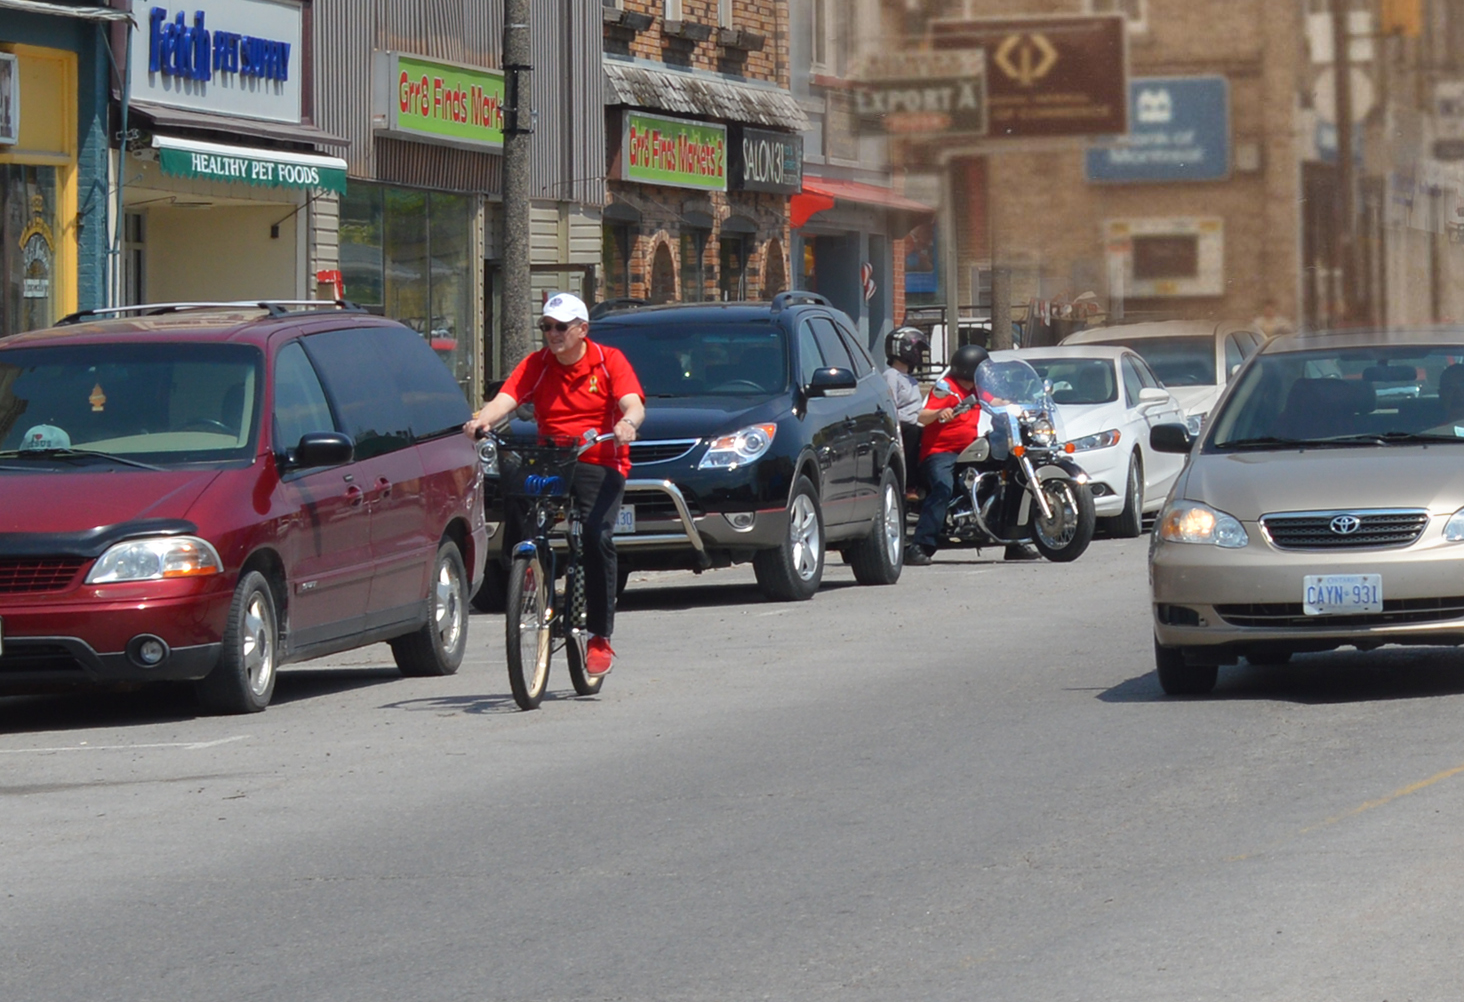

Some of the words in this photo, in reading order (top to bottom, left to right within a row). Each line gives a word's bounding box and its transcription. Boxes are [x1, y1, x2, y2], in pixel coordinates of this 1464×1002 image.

[150, 7, 211, 81] Fetch
[213, 30, 241, 73] PET
[241, 35, 291, 81] SUPPLY
[399, 70, 429, 117] Grr8
[433, 77, 468, 124] Finds
[191, 152, 248, 178] HEALTHY
[252, 161, 274, 180] PET
[278, 164, 319, 185] FOODS
[630, 124, 649, 168] Grr8
[678, 132, 715, 177] Markets
[717, 139, 723, 177] 2
